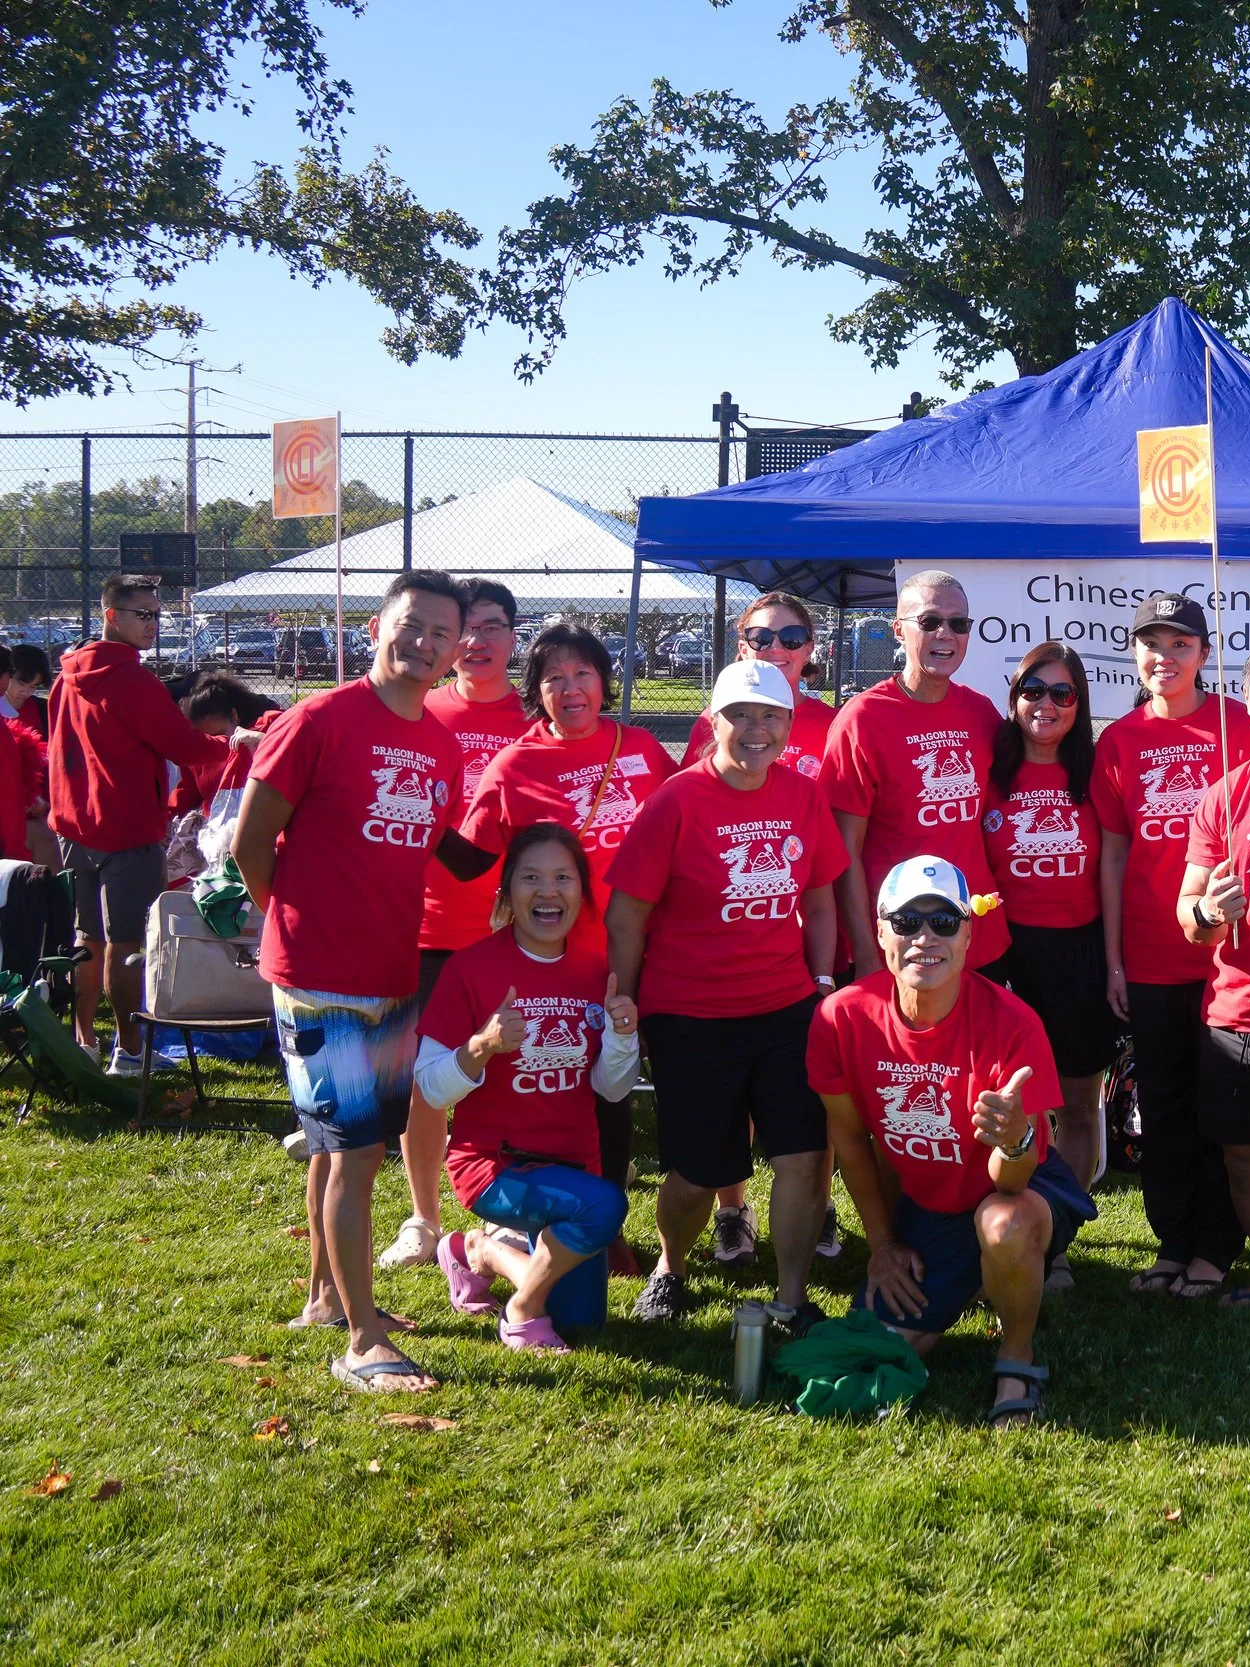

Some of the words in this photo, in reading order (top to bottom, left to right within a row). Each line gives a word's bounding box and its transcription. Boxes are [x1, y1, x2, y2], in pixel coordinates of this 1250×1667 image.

[978, 616, 1031, 643] On
[1045, 616, 1129, 651] Long
[455, 733, 484, 741] AGON
[486, 734, 516, 745] BOAT
[459, 740, 500, 750] STIVAL
[906, 730, 946, 744] DRAGON
[948, 730, 969, 738] BOAT
[920, 739, 963, 751] FESTIVAL
[372, 746, 414, 759] DRAGON
[416, 752, 437, 767] BOAT
[783, 746, 802, 754] AT
[1140, 745, 1185, 760] DRAGON
[1186, 744, 1216, 753] BOAT
[384, 756, 427, 772] FESTIVAL
[1151, 752, 1202, 765] FESTIVAL
[558, 764, 602, 782] DRAGON
[1009, 790, 1054, 802] DRAGON
[1057, 790, 1072, 798] BO
[1021, 798, 1072, 808] FESTIVAL
[918, 798, 980, 826] CCLI
[362, 820, 432, 849] CCLI
[716, 821, 763, 836] DRAGON
[765, 820, 792, 830] BOAT
[1140, 816, 1194, 840] CC
[730, 830, 782, 844] FESTIVAL
[1010, 855, 1087, 878] CCLI
[721, 896, 798, 923] CCLI
[512, 998, 558, 1008] DRAGON
[560, 998, 588, 1008] BOAT
[524, 1007, 578, 1016] FESTIVAL
[876, 1060, 928, 1074] DRAGON
[930, 1062, 960, 1077] BOAT
[512, 1068, 586, 1094] CCLI
[890, 1072, 944, 1086] FESTIVAL
[884, 1133, 964, 1165] CCLI
